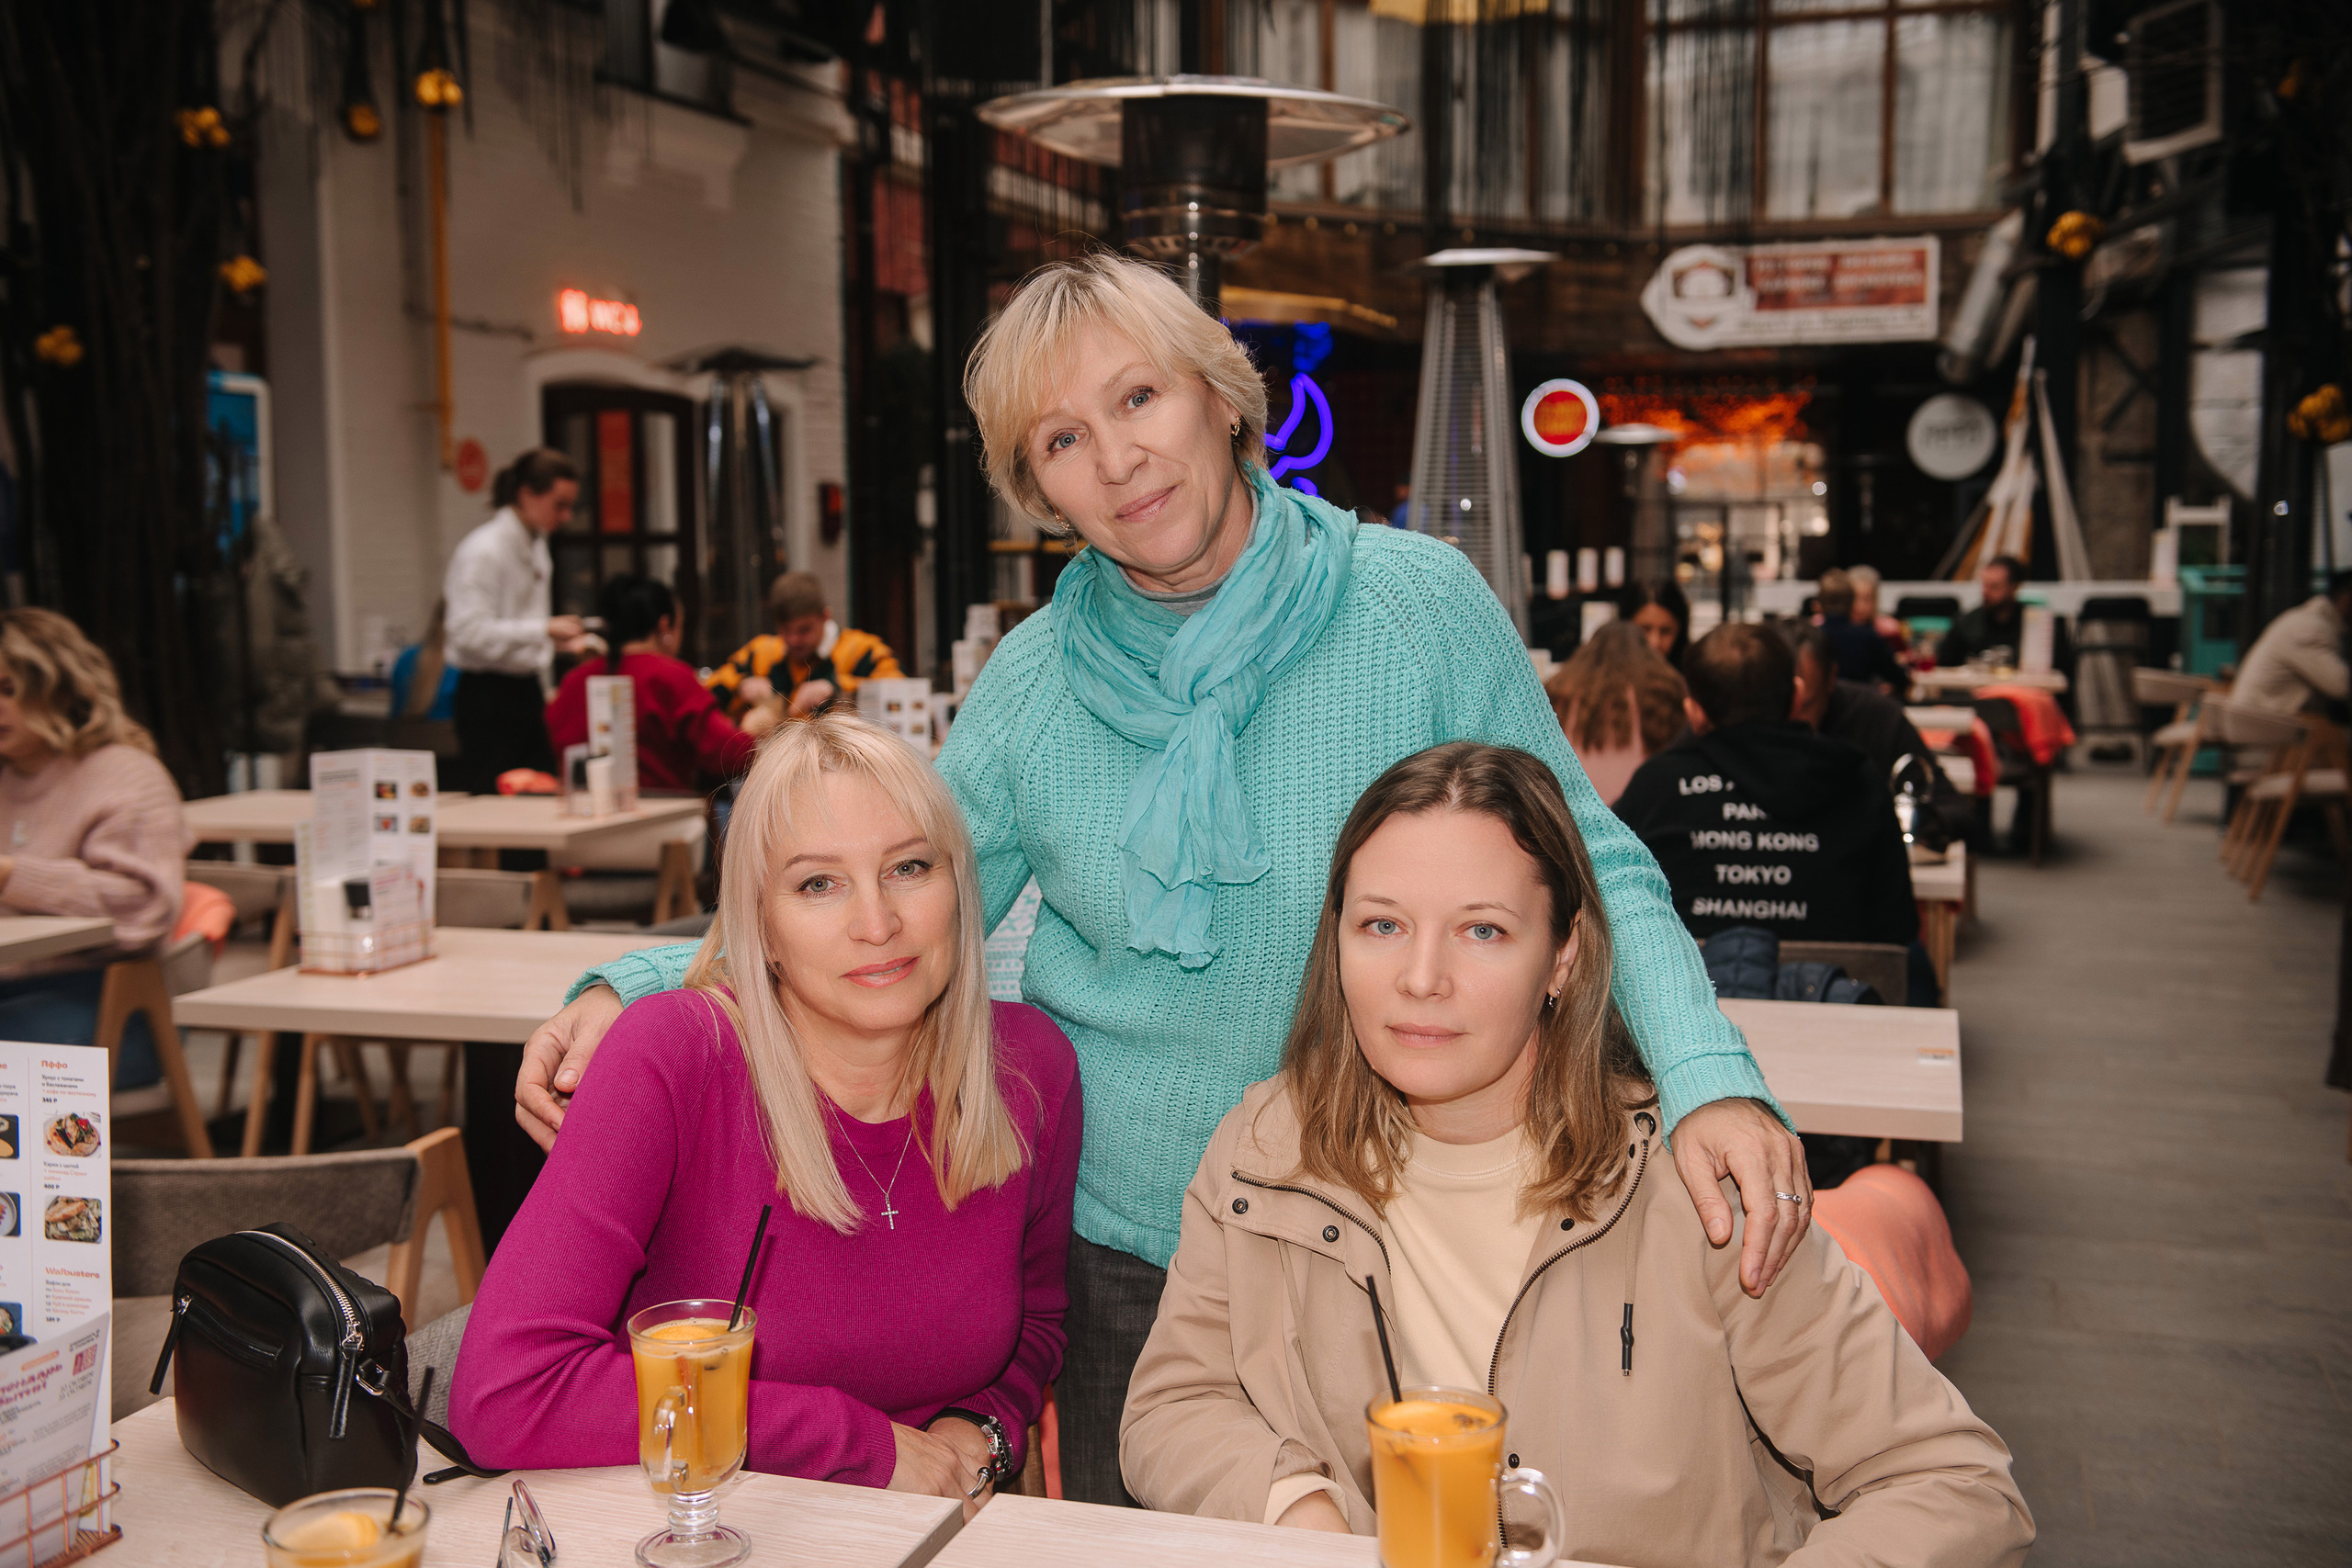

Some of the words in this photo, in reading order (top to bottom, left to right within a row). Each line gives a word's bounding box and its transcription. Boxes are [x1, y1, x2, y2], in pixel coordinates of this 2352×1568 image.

[1678, 773, 1724, 796] LOS
[1690, 829, 1753, 851] HONG
[1757, 831, 1820, 852] KONG
[1714, 863, 1792, 886] TOKYO
[1691, 897, 1808, 920] SHANGHAI
